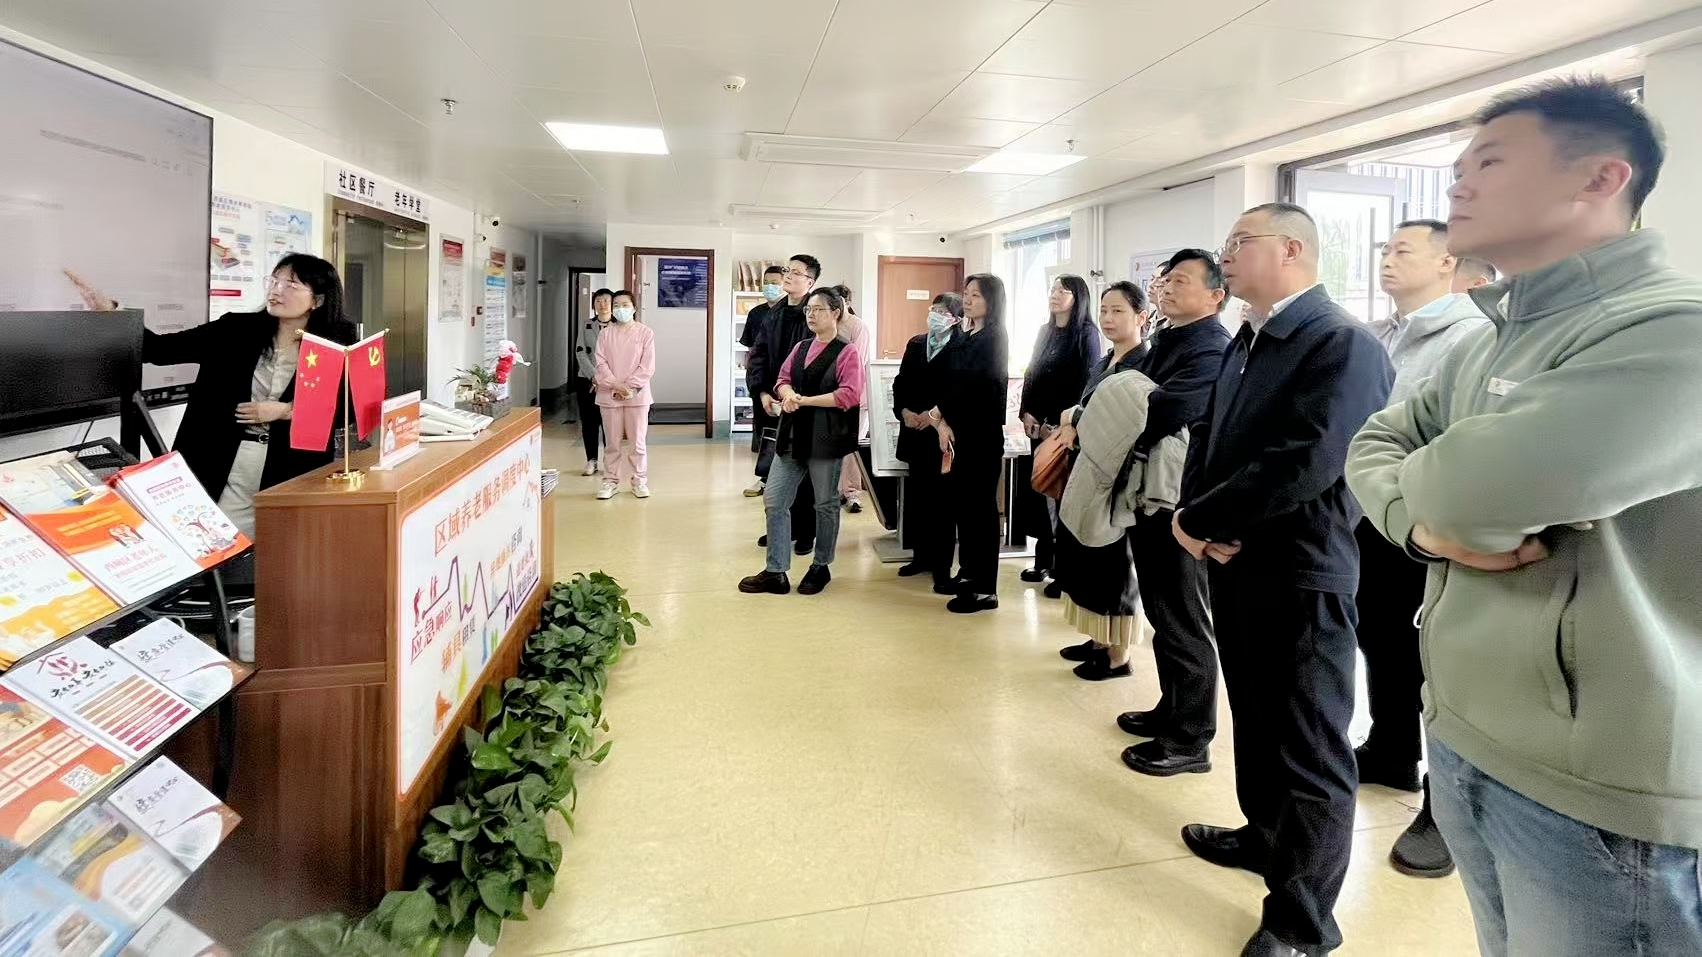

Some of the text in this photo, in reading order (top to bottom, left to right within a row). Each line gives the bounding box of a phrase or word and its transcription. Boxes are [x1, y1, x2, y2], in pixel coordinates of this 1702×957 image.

[339, 169, 375, 197] 社区餐厅
[395, 191, 421, 213] 老年学堂
[434, 453, 530, 557] 区域养老服务调度中心
[410, 600, 452, 664] 应急响应
